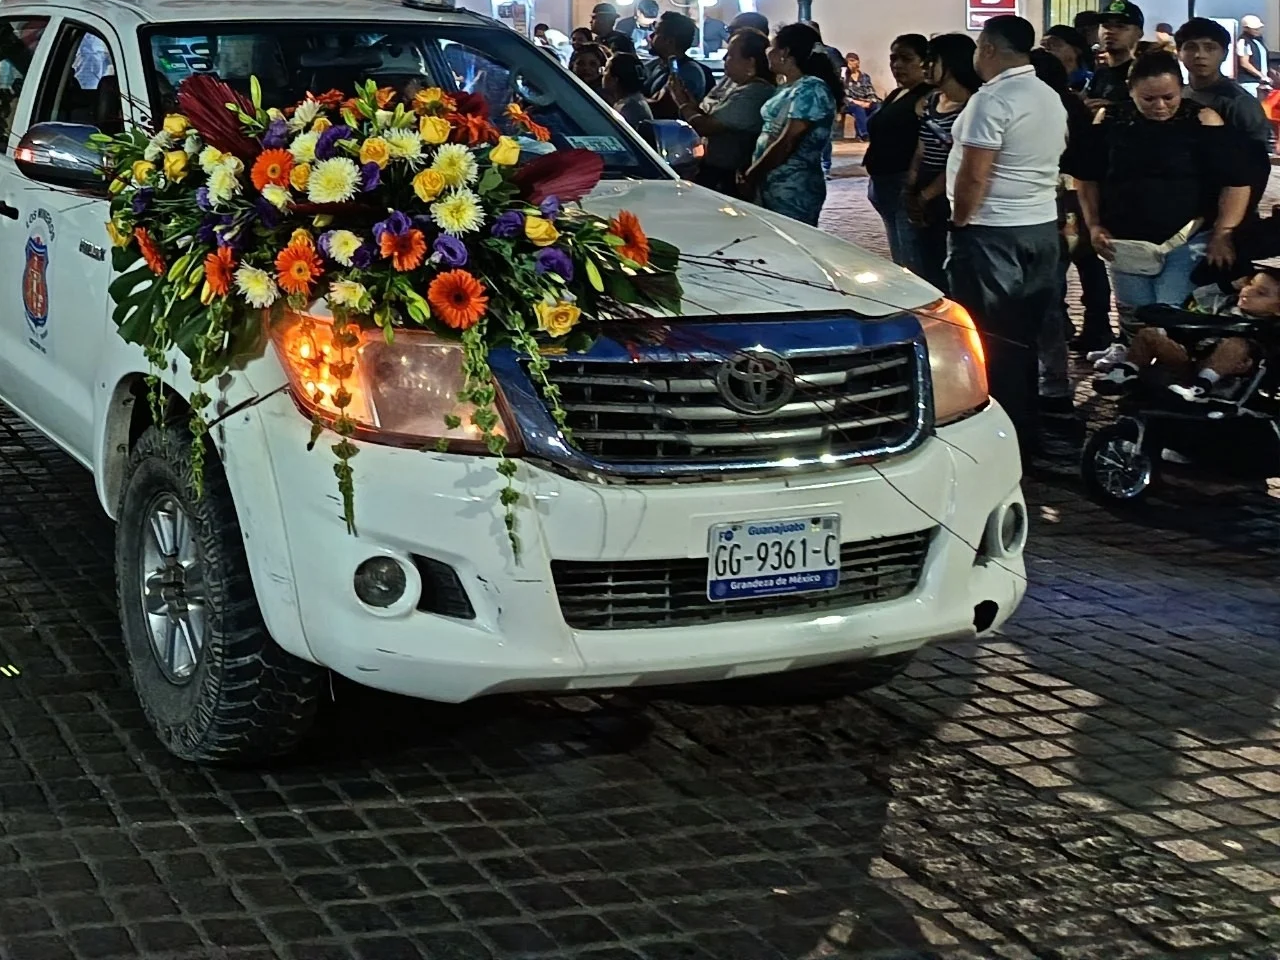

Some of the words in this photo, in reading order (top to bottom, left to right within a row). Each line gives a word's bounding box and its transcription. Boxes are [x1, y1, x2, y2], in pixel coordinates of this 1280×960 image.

[748, 522, 806, 536] Guanajuato
[714, 534, 837, 577] GG-9361-C
[730, 578, 774, 590] Grandeza
[775, 576, 787, 587] de
[788, 573, 821, 585] México
